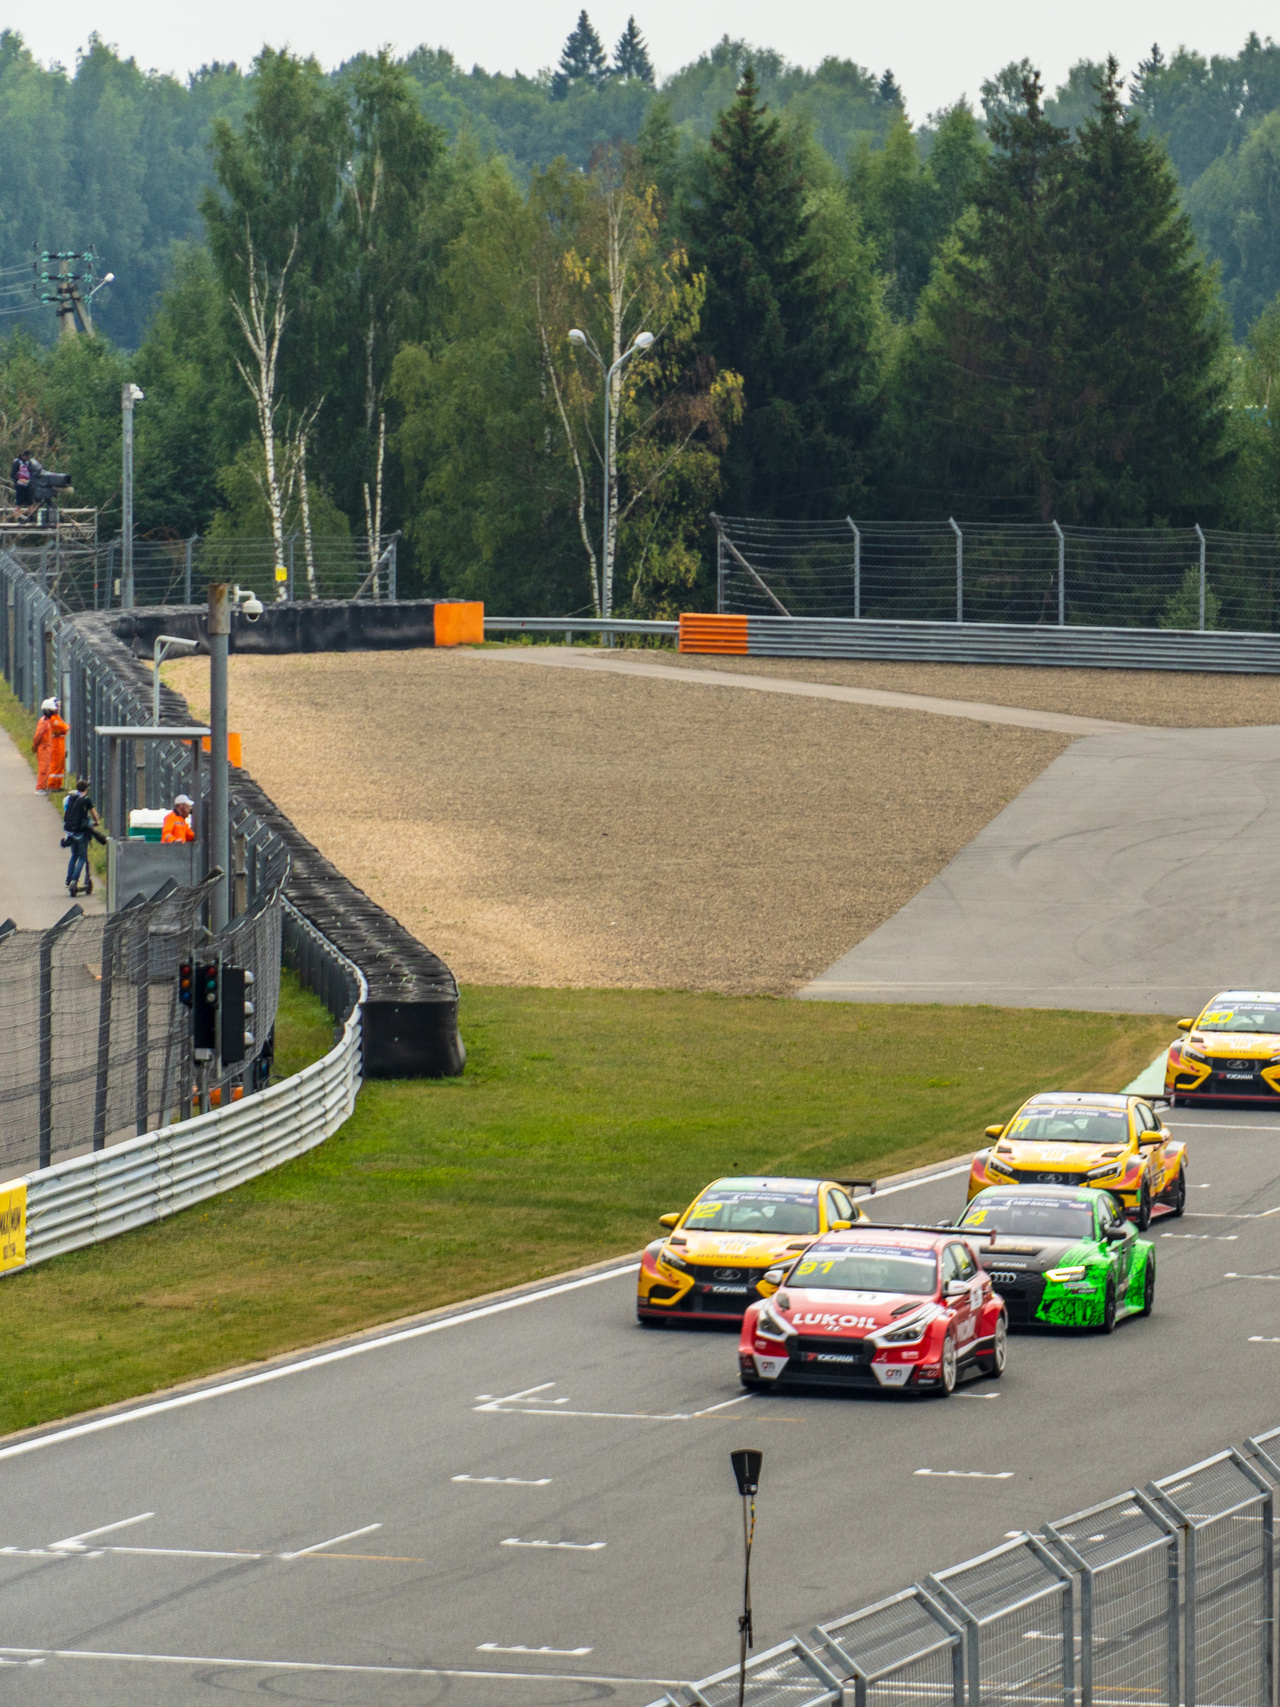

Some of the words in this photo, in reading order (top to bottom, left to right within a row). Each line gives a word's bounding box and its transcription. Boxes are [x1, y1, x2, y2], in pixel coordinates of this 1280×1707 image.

[1199, 1012, 1234, 1026] 30
[1010, 1118, 1031, 1133] 11
[691, 1203, 723, 1219] 12
[964, 1210, 989, 1226] 4
[796, 1260, 835, 1276] 91
[712, 1285, 748, 1294] YOKOHAMA
[791, 1312, 879, 1330] LUKOIL
[817, 1353, 854, 1363] YOKOHAMA
